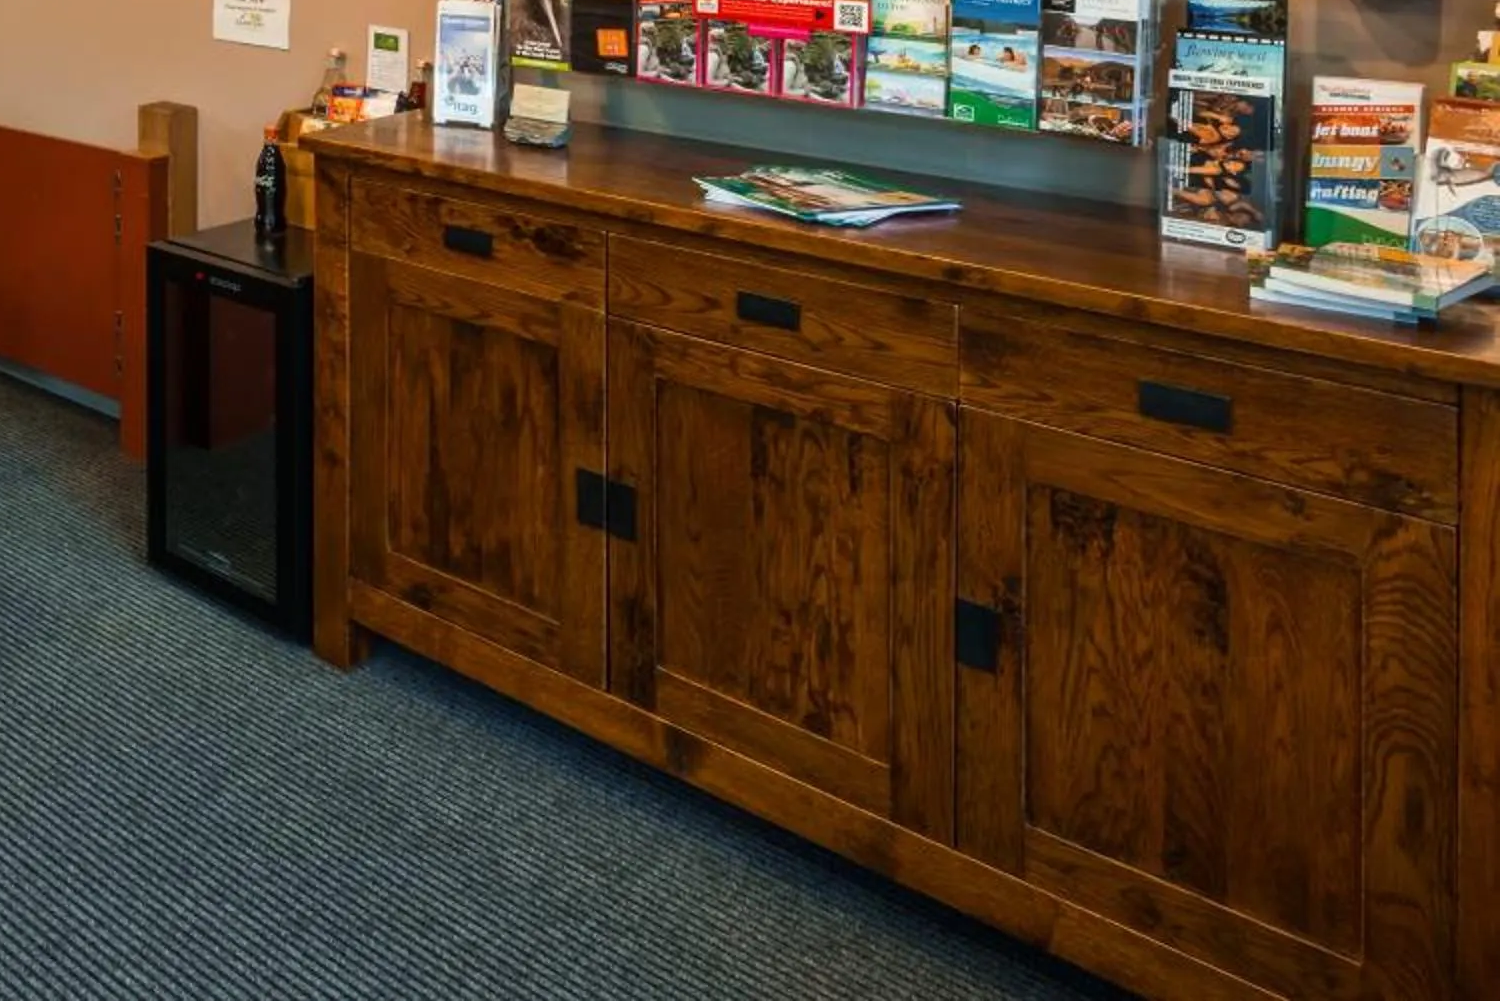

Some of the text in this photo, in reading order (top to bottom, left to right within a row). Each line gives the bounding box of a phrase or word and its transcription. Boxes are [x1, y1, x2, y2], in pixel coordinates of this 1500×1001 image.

[1314, 122, 1337, 138] jet
[1312, 152, 1379, 172] bungy
[1309, 182, 1379, 202] rafting
